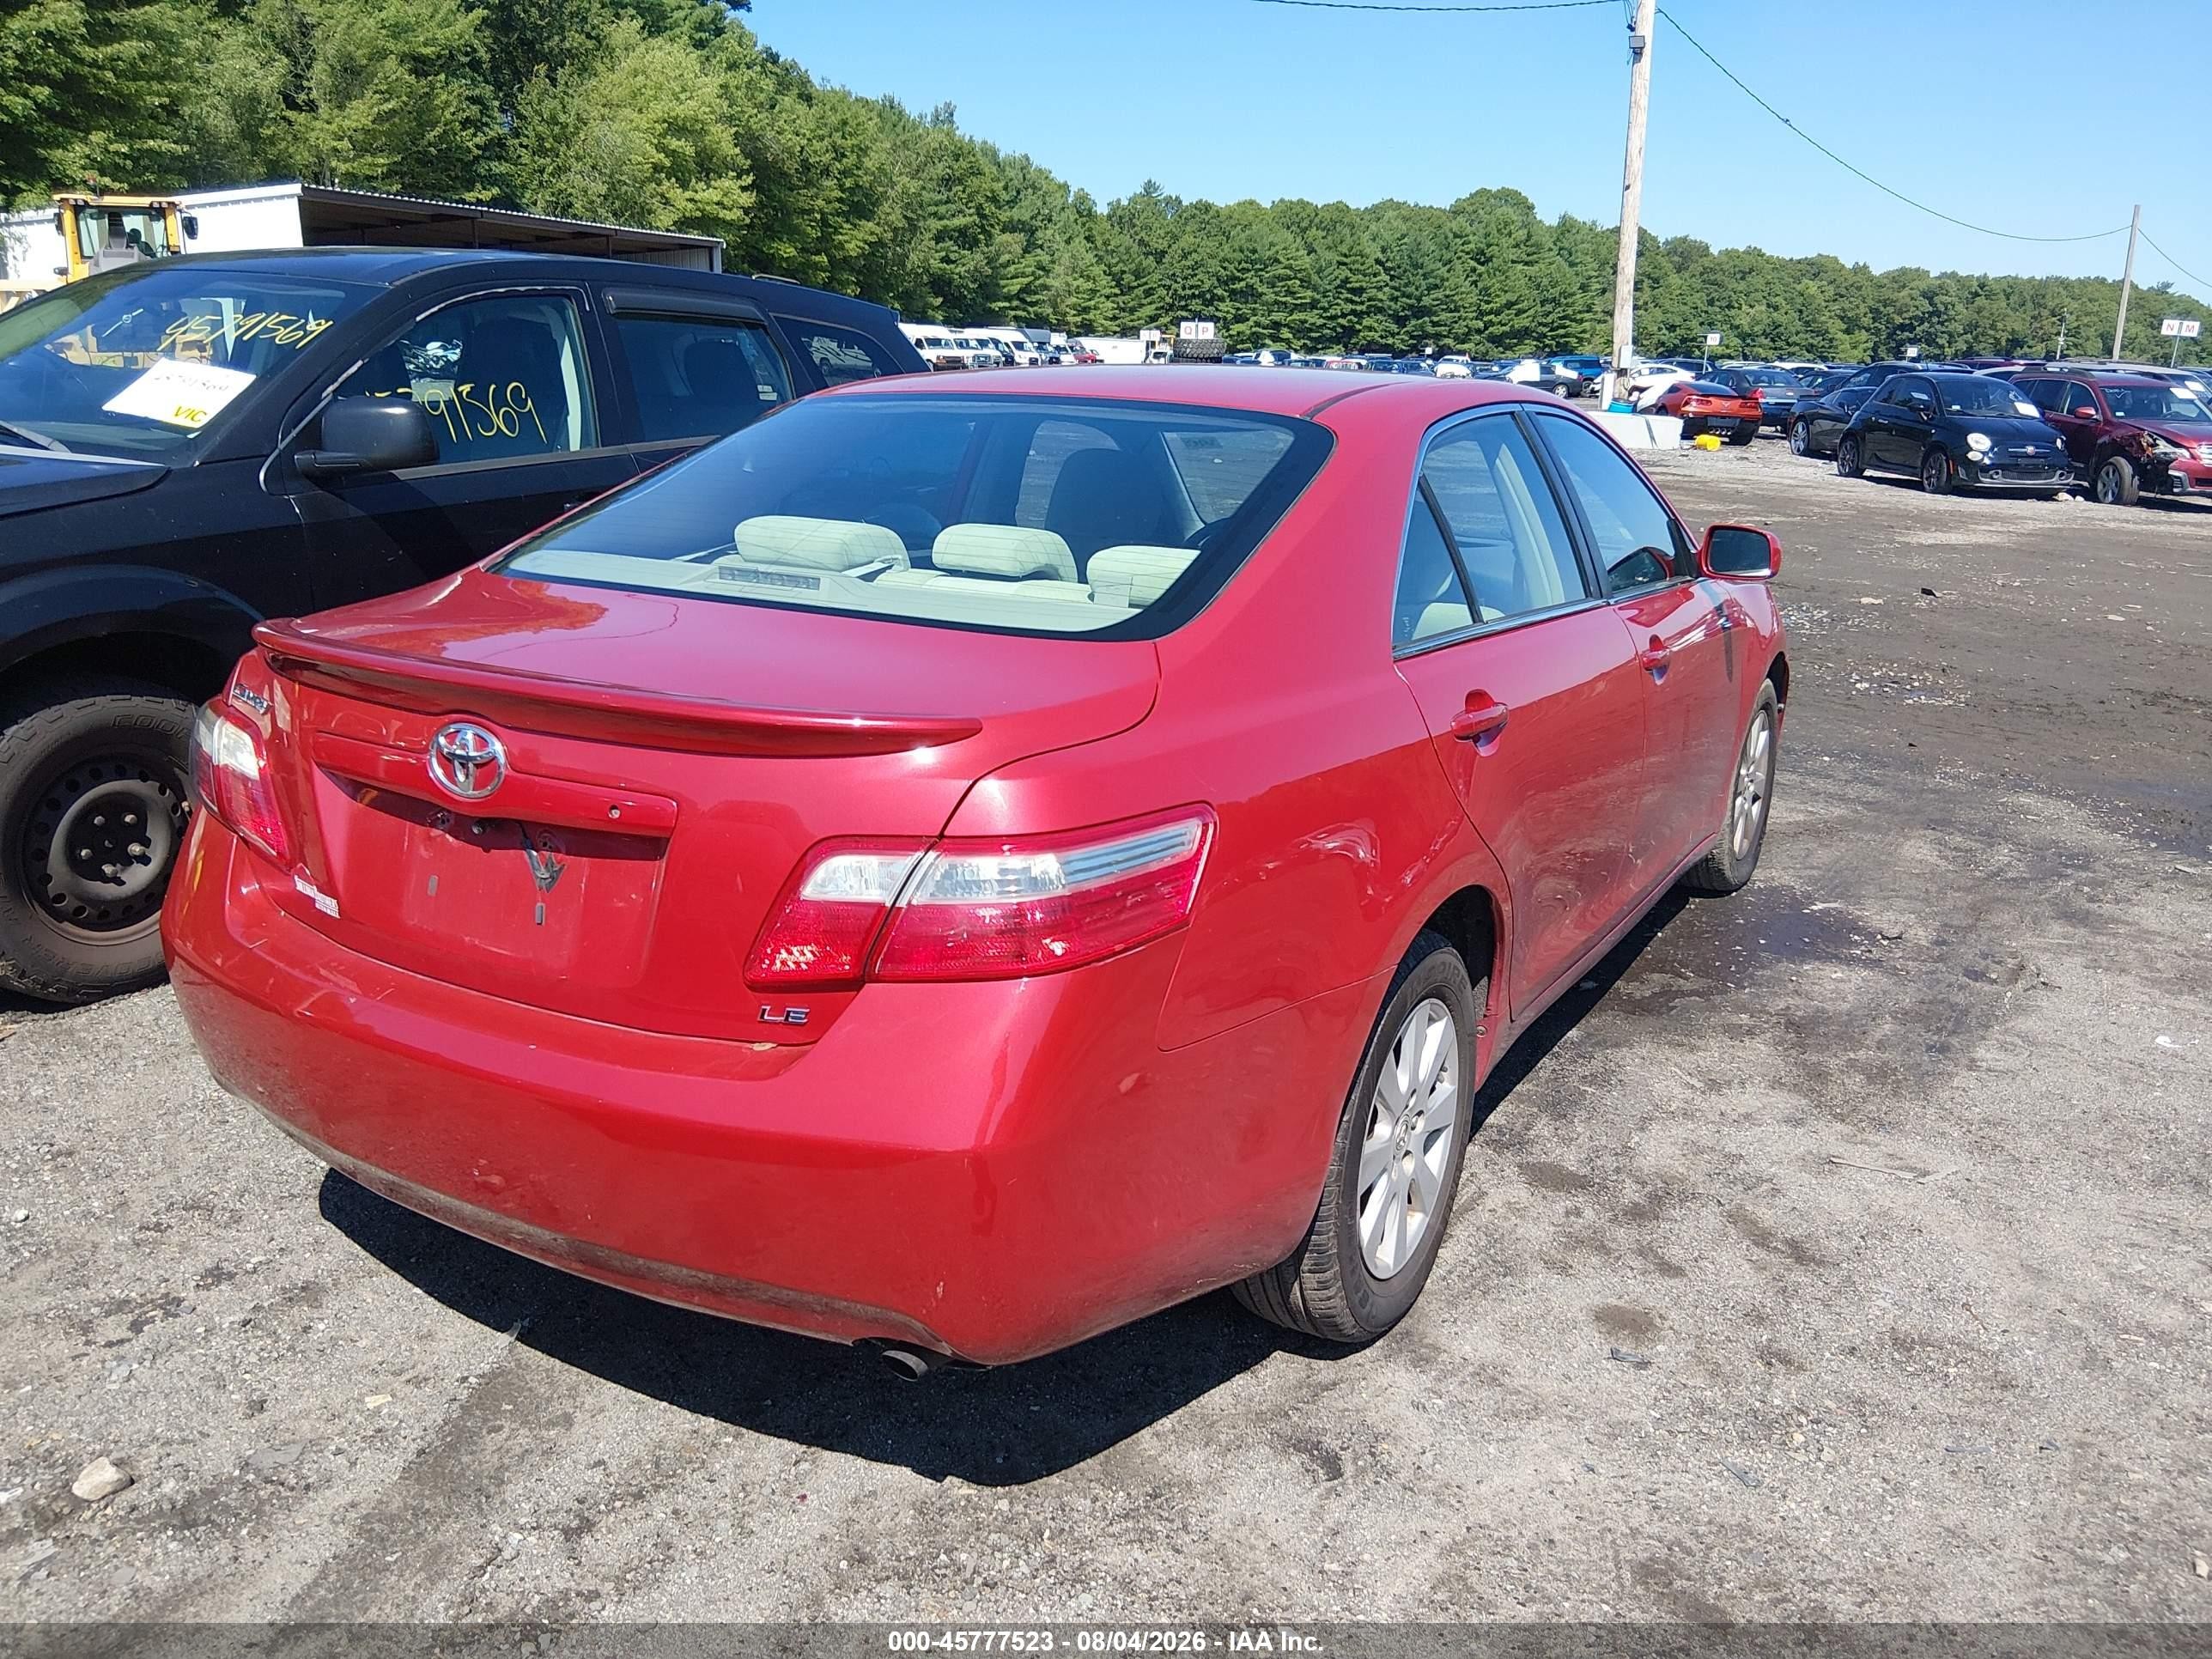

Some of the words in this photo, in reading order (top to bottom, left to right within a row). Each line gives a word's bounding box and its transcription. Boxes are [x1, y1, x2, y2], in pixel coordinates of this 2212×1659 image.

[156, 311, 333, 349] 45791569
[1184, 326, 1193, 335] Q
[1201, 326, 1209, 335] P
[2166, 323, 2175, 331] N
[2185, 325, 2195, 333] M
[173, 405, 208, 422] VIC
[757, 1005, 811, 1024] LE
